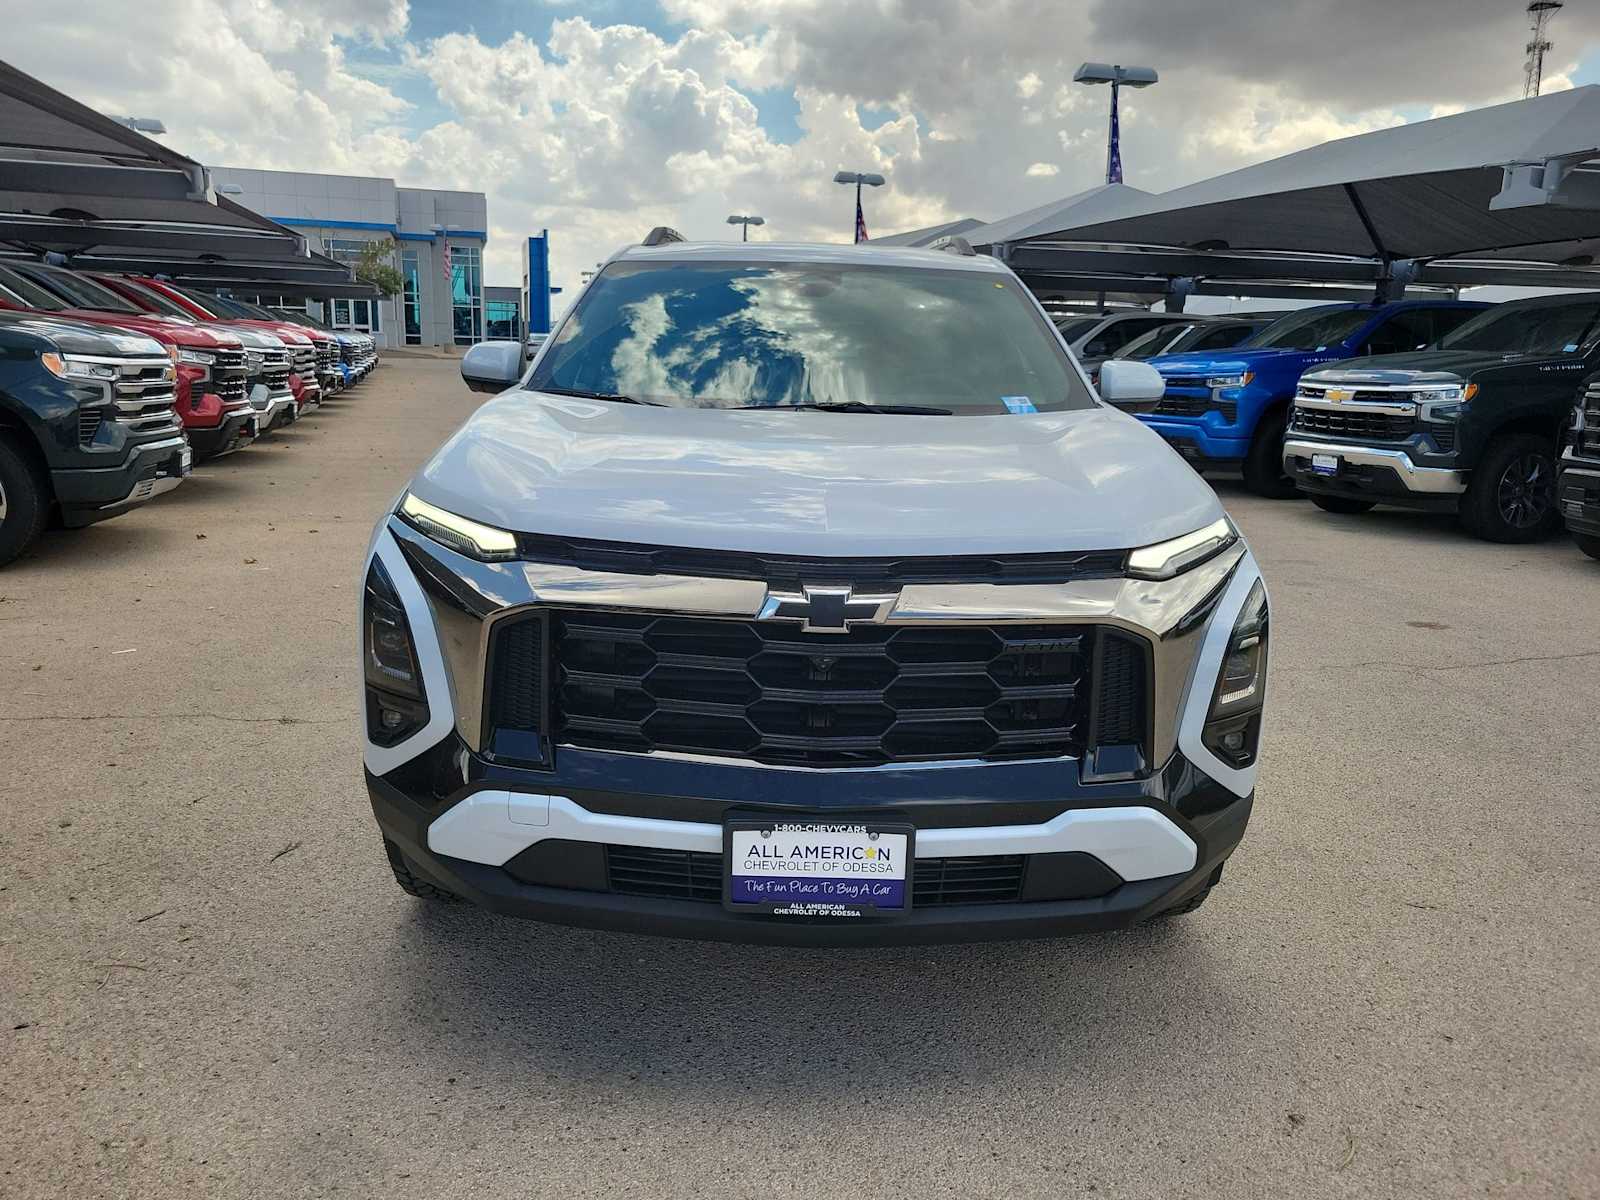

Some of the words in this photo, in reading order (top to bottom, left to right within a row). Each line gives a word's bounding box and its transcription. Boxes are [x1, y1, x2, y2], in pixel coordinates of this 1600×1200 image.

[774, 824, 867, 833] 1-800-CHEVYCARS
[748, 845, 783, 858] ALL
[744, 860, 817, 872] CHEVROLET
[822, 862, 839, 872] OF
[843, 862, 893, 873] ODESSA
[744, 880, 764, 892] The
[766, 881, 787, 893] Fun
[789, 880, 819, 893] Place
[821, 881, 834, 893] To
[836, 882, 859, 898] Buy
[860, 883, 870, 895] A
[872, 883, 892, 895] Car
[773, 908, 817, 916] CHEVROLET
[831, 909, 861, 917] ODESSA
